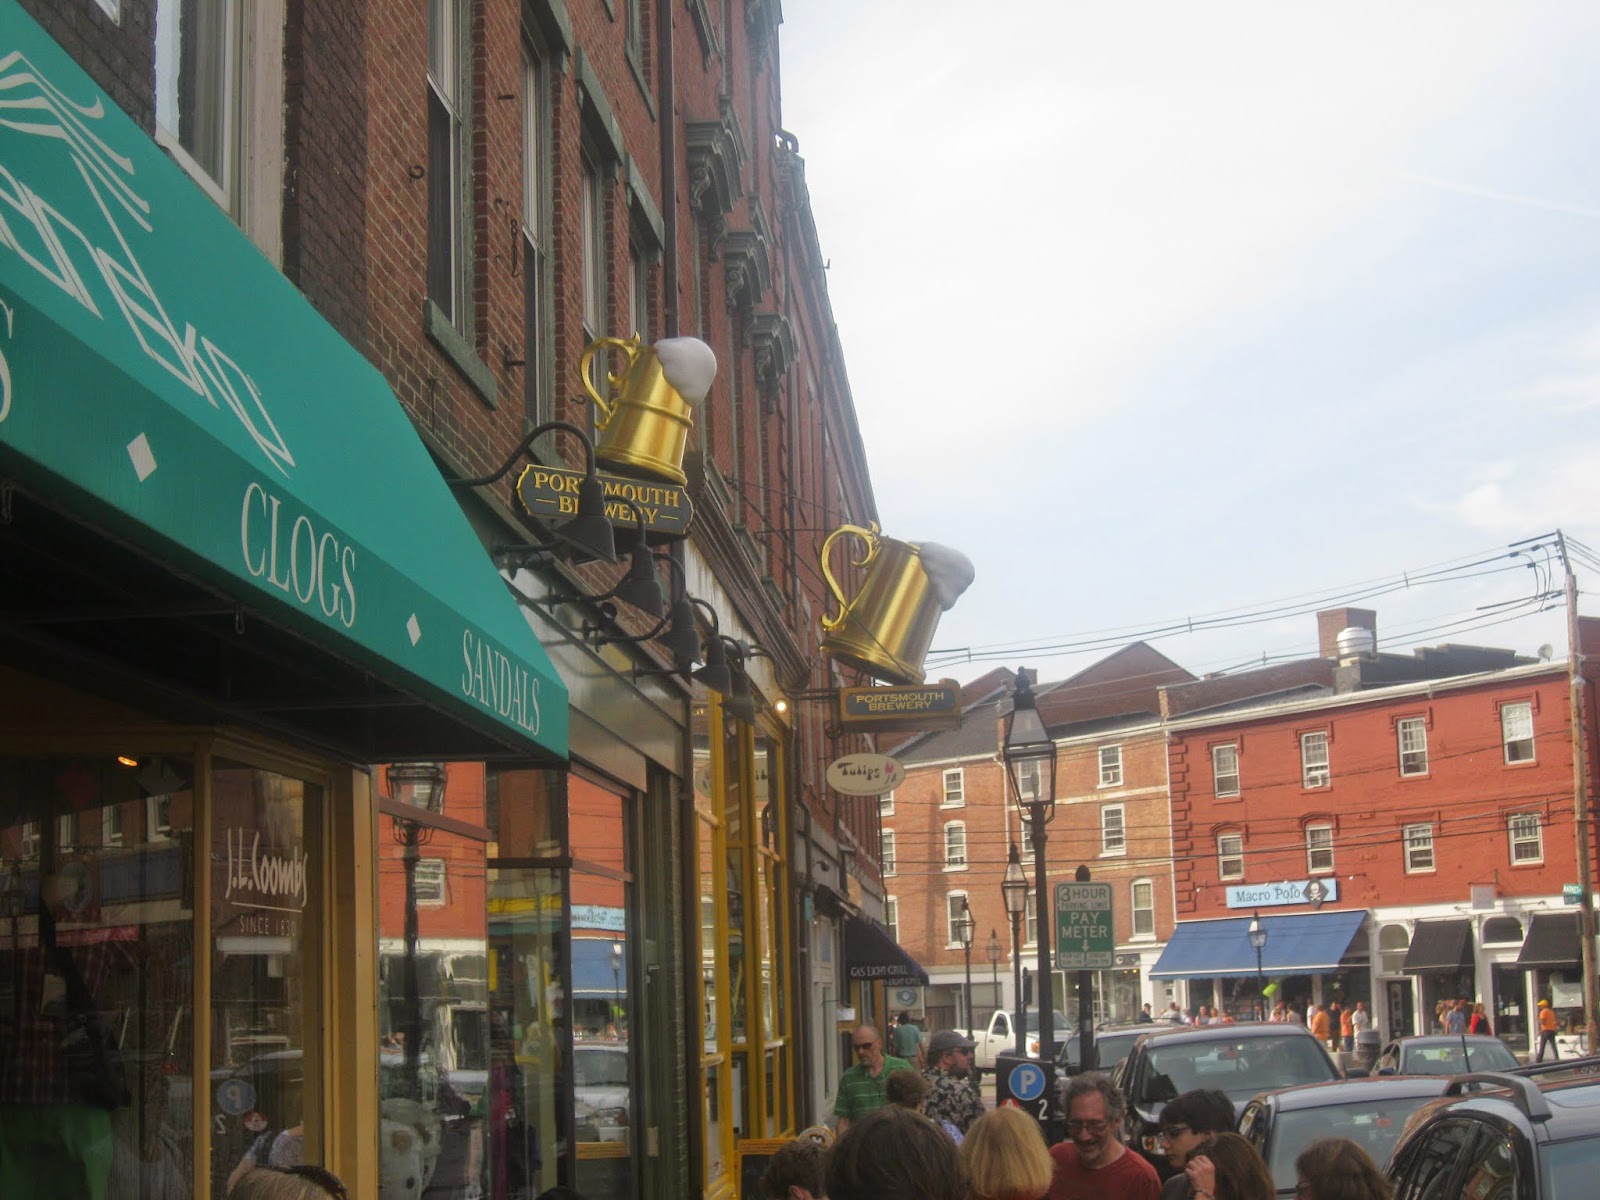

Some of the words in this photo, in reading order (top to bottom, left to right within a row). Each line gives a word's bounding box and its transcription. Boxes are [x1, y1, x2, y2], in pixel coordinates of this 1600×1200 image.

[241, 482, 356, 628] CLOGS
[461, 628, 541, 736] SANDALS
[856, 692, 944, 704] PORTSMOUTH
[868, 701, 932, 711] BREWERY
[837, 762, 880, 781] Tulips
[1061, 887, 1071, 902] 3
[1072, 888, 1106, 899] HOUR
[1236, 891, 1271, 903] Macro
[1275, 885, 1301, 900] Polo
[240, 915, 269, 935] SINCE
[1070, 912, 1099, 924] PAY
[1061, 925, 1107, 938] METER
[1021, 1070, 1036, 1094] P
[1039, 1099, 1048, 1120] 2
